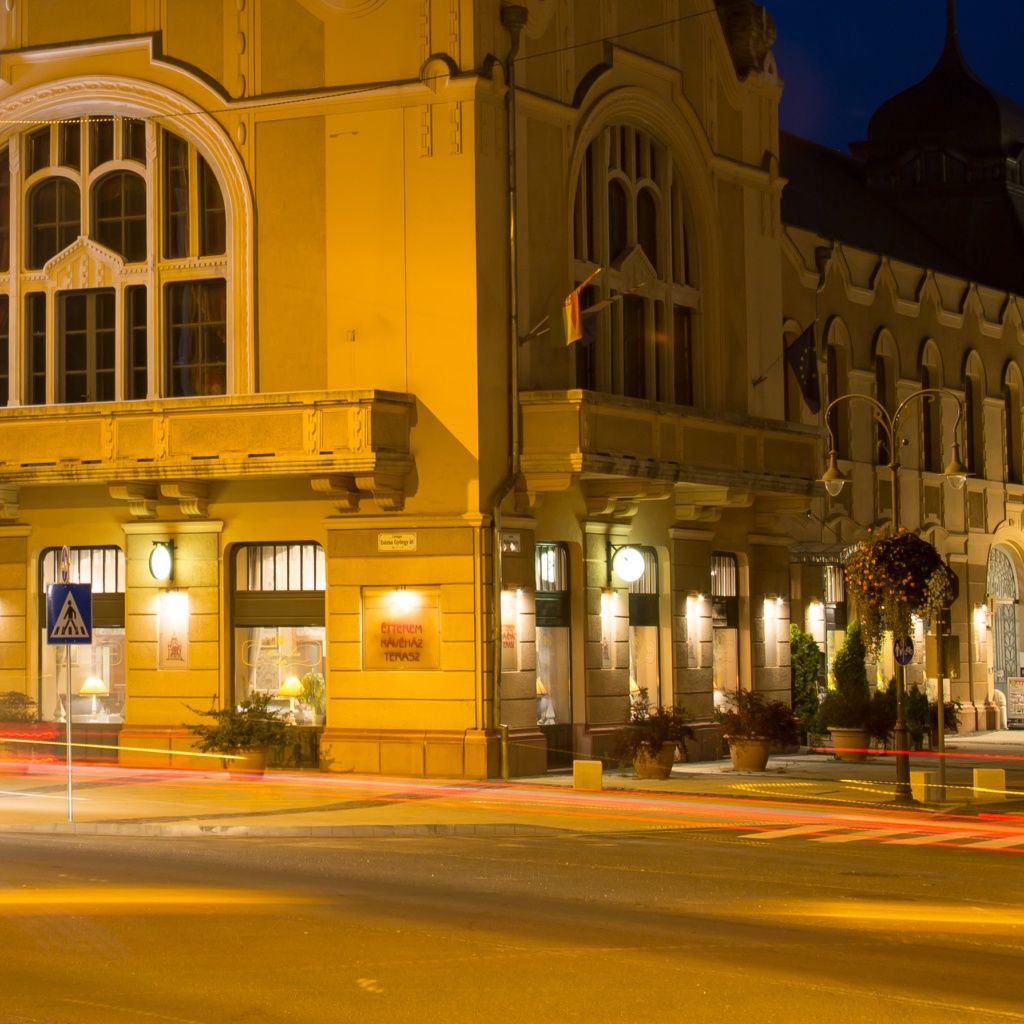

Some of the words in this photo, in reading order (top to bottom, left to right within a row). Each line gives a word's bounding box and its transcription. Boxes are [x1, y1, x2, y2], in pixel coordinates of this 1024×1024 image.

[380, 621, 423, 634] ÉTTEREM
[380, 636, 423, 649] KÁVÉHÁZ
[384, 652, 421, 662] TERASZ
